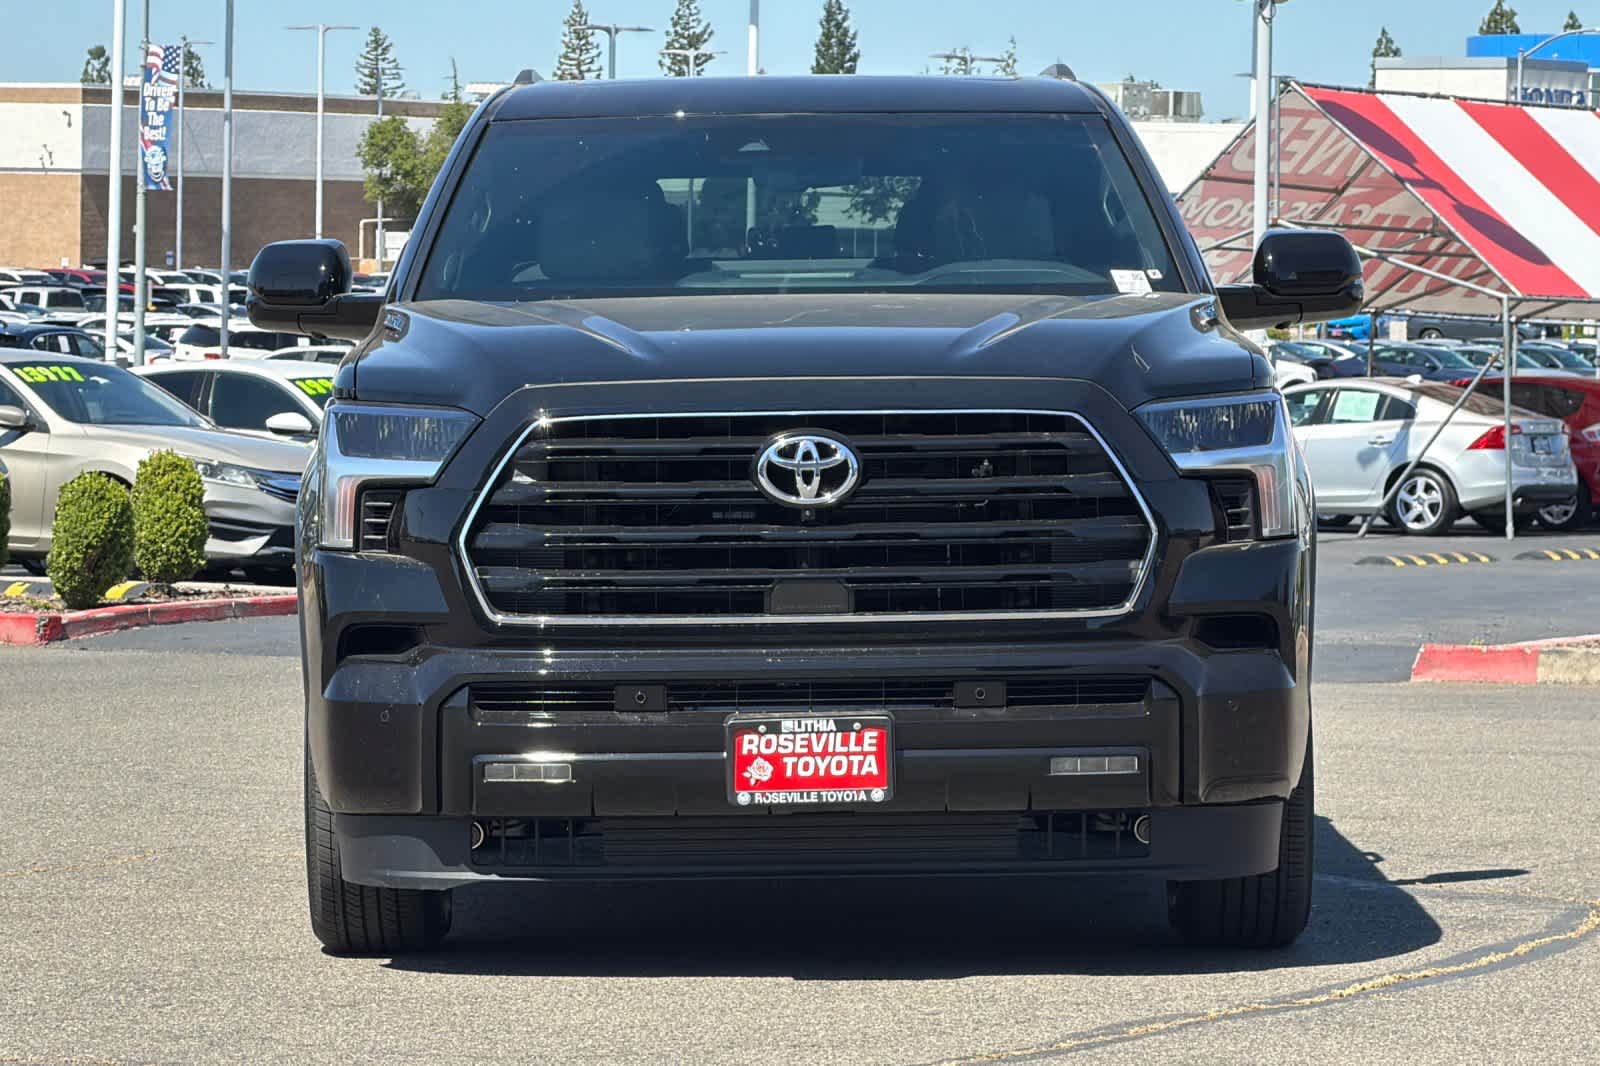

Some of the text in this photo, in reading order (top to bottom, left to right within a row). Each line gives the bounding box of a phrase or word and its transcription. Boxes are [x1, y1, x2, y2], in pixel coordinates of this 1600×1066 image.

[143, 83, 176, 97] Driven
[144, 97, 170, 111] To Be
[147, 111, 165, 126] The
[143, 126, 167, 141] Best!
[12, 366, 85, 383] 13977
[795, 719, 837, 732] LITHIA
[742, 731, 878, 755] ROSEVILLE
[783, 754, 879, 777] TOYOTA
[755, 790, 867, 804] ROSEVILLE TOYOTA
